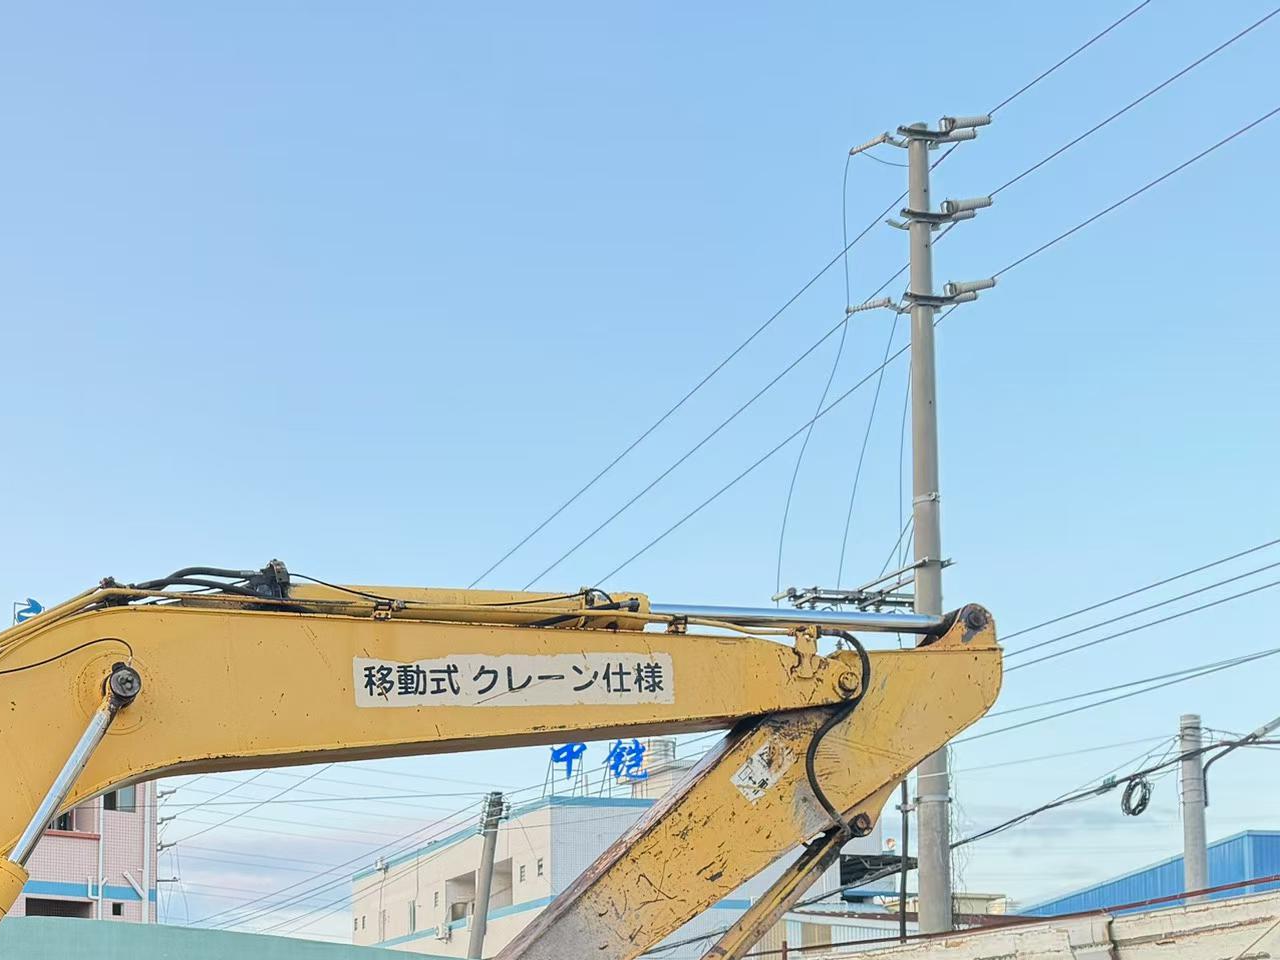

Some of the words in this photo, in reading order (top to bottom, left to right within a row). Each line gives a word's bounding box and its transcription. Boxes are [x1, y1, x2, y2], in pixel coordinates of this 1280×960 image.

[363, 662, 665, 697] 移動式クレーン仕様
